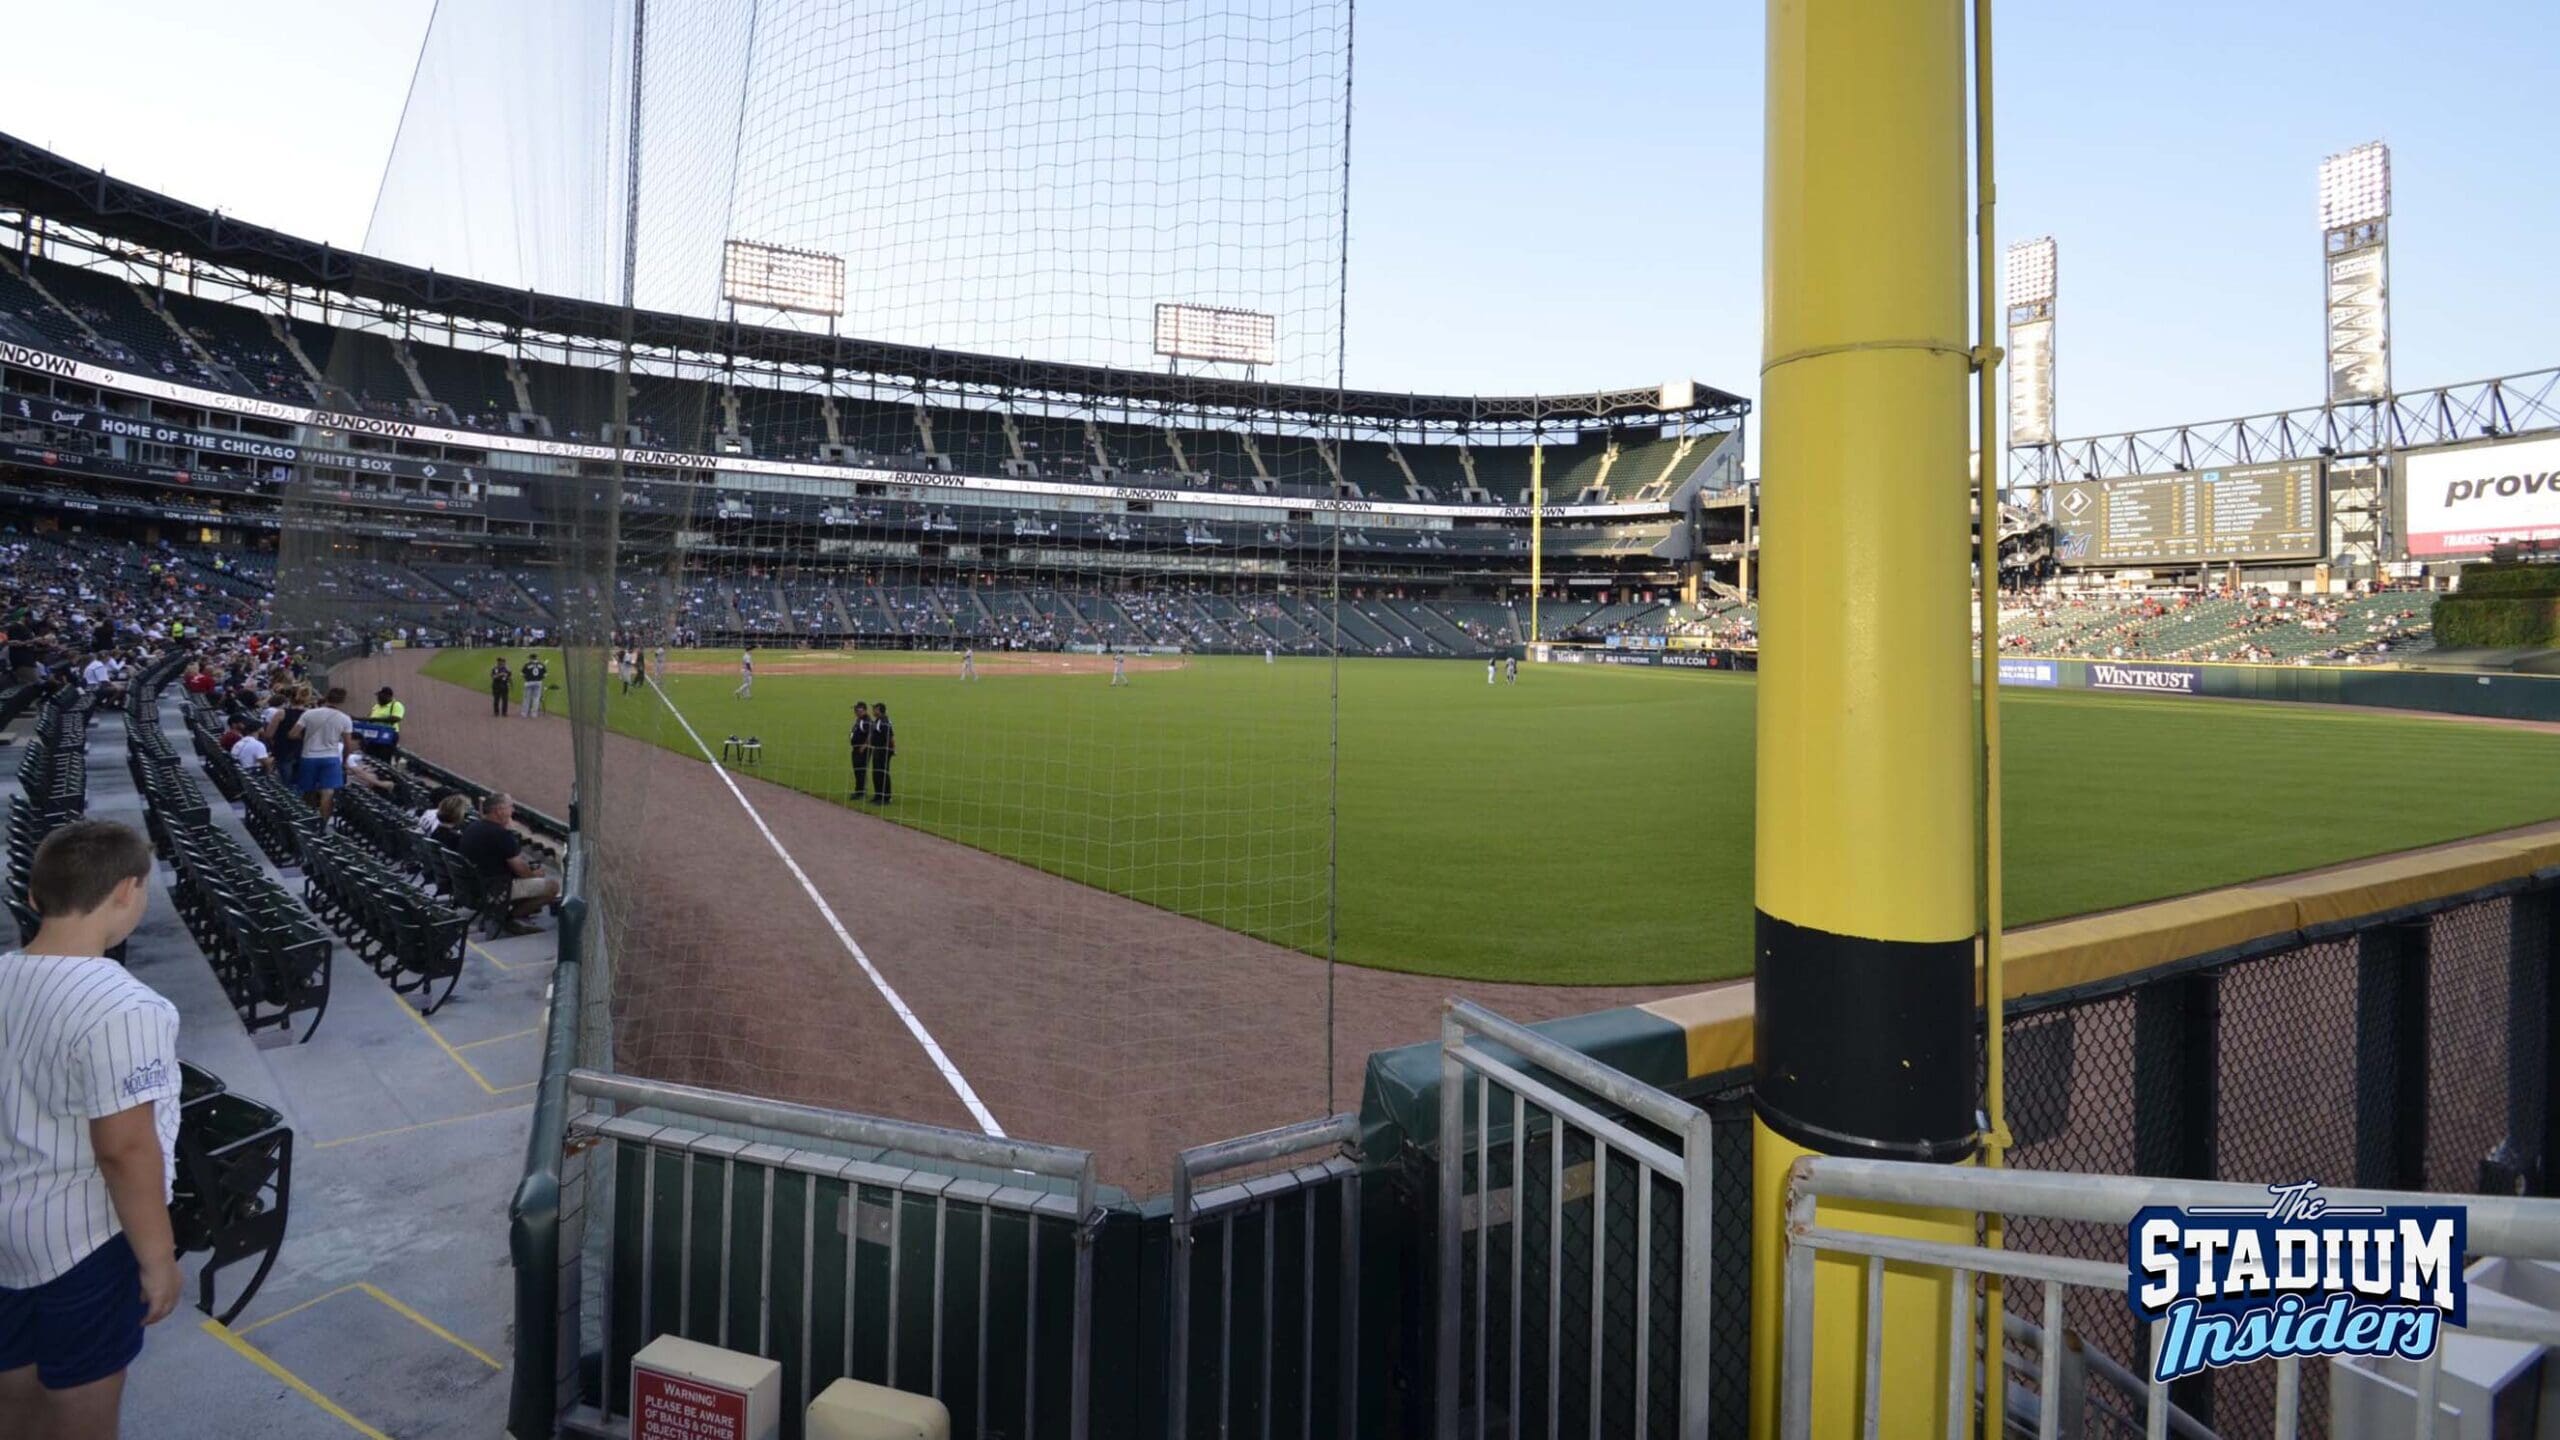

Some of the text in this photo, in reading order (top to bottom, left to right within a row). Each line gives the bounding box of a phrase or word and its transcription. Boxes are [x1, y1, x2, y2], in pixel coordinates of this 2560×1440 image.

[314, 412, 417, 437] RUNDOWN
[101, 418, 393, 472] HOME OF THE CHICAGO WHITE SOX
[633, 450, 718, 467] RUNDOWN
[894, 471, 965, 487] RUNDOWN
[1116, 486, 1178, 501] RUNDOWN
[1315, 500, 1372, 511] RUNDOWN
[1505, 507, 1566, 517] RUNOWN
[1662, 656, 1708, 666] RATE.COM
[2093, 665, 2194, 690] WINTRUST
[644, 1394, 735, 1428] PLEASE BE AWARE
[644, 1407, 658, 1419] OF
[660, 1411, 690, 1429] BALLS
[691, 1421, 699, 1432] &
[700, 1423, 734, 1440] OTHER
[645, 1421, 689, 1440] OBJECTS
